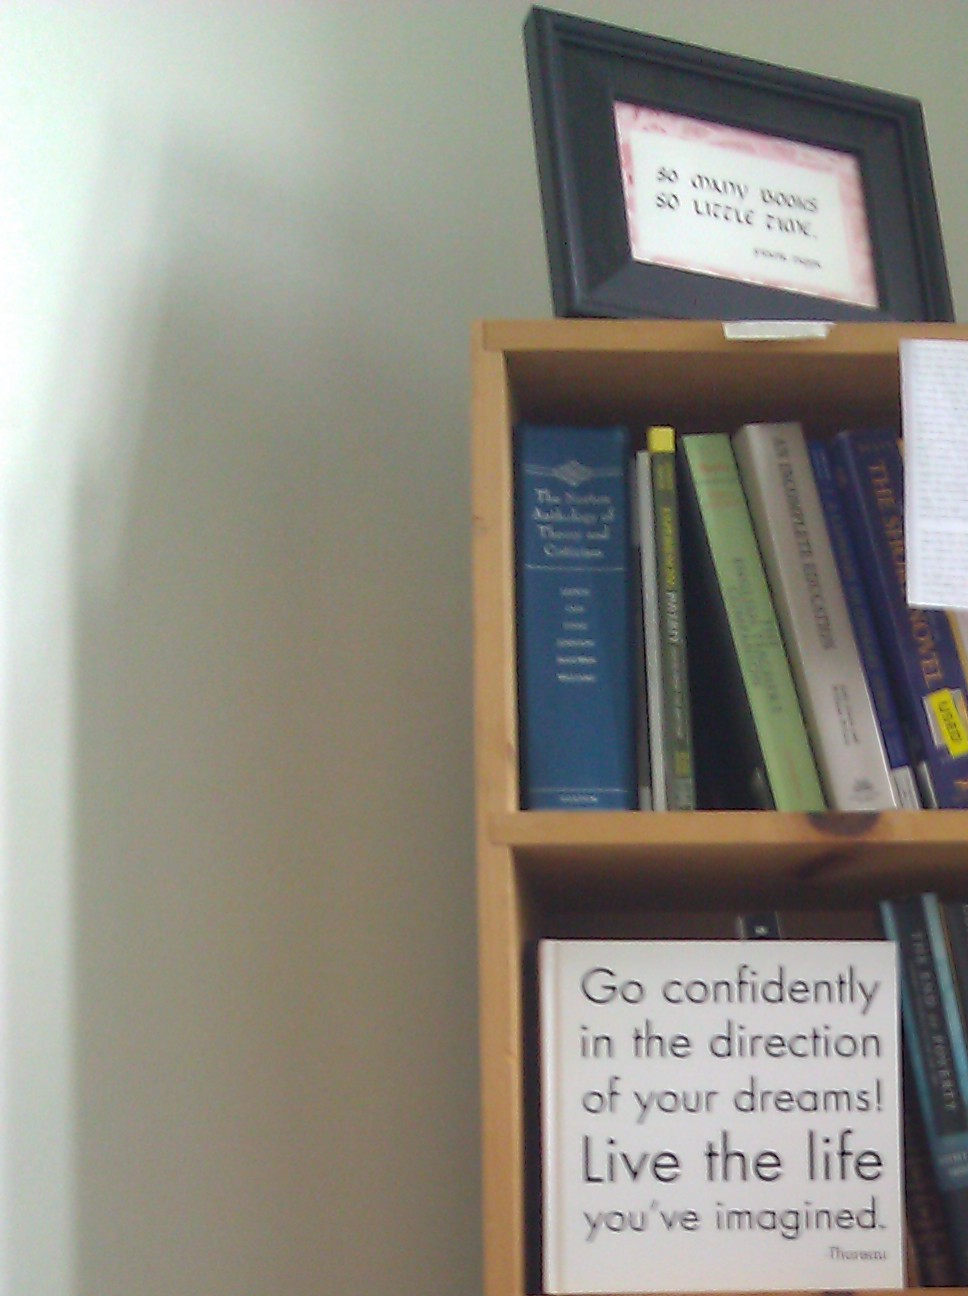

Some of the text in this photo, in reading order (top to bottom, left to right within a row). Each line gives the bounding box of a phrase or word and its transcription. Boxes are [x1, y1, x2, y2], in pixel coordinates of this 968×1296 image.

[581, 964, 881, 1015] Go confidently
[581, 1019, 882, 1058] in the direction
[582, 1076, 883, 1124] of your dreams!
[582, 1134, 682, 1183] Live
[704, 1130, 782, 1182] the
[807, 1130, 883, 1182] life
[583, 1195, 886, 1242] you've imagined.
